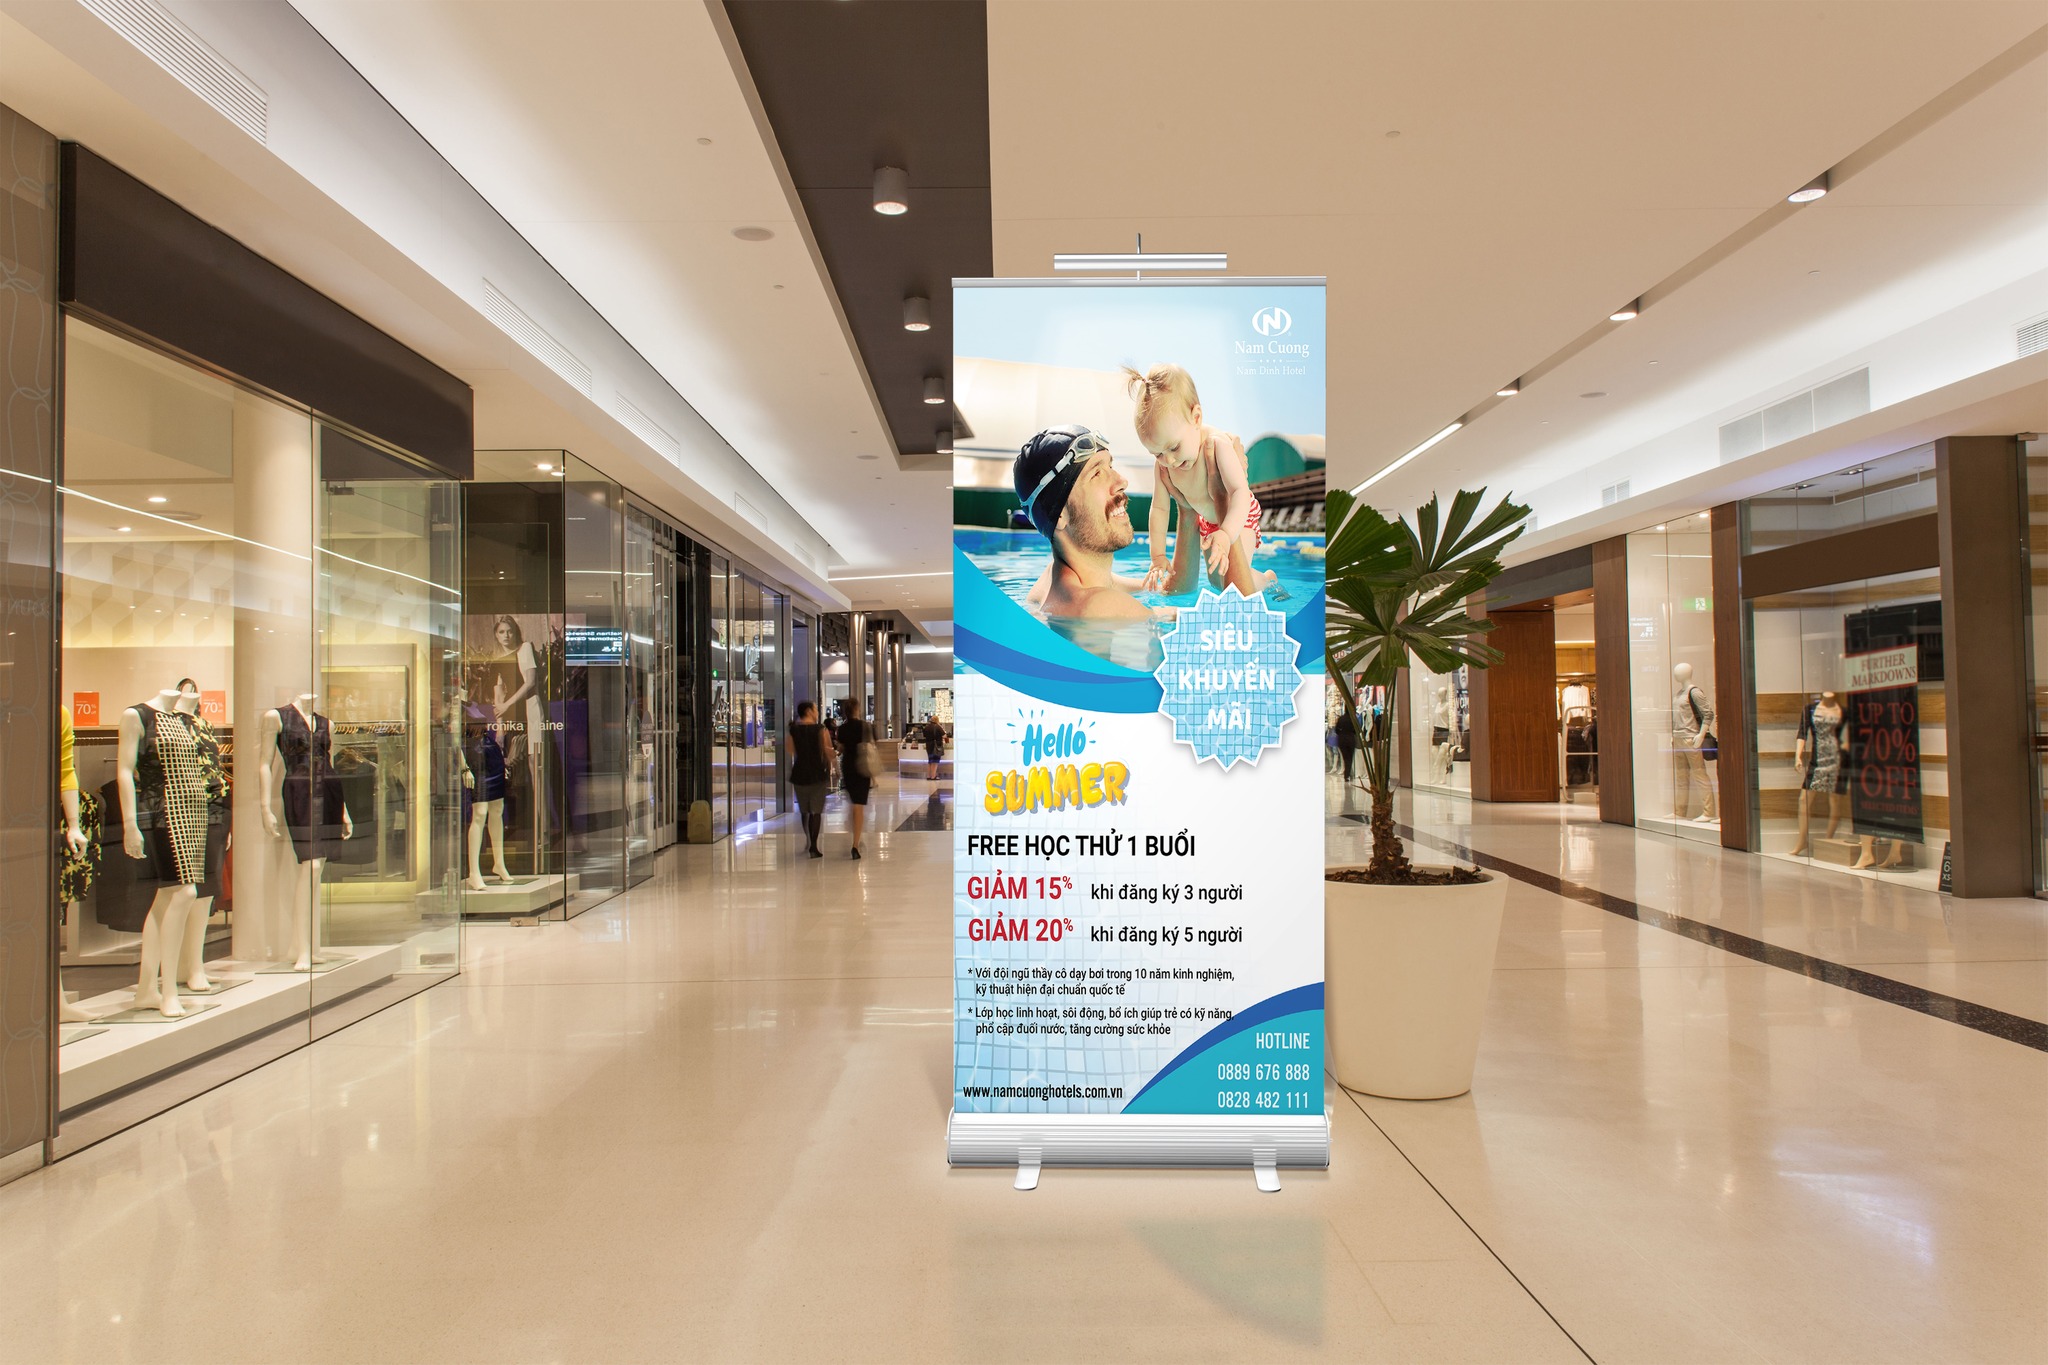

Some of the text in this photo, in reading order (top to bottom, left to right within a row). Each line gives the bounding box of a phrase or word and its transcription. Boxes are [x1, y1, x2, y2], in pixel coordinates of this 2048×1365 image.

[1235, 340, 1310, 358] Nam Cuong
[1236, 365, 1306, 375] Nam Dinh Hotel
[1200, 621, 1253, 651] SIÊU
[1861, 652, 1906, 672] FURTHER
[1178, 656, 1275, 691] KHUYẾN
[1851, 666, 1917, 688] MARKDOWNS
[1207, 701, 1251, 730] MÃI
[1858, 702, 1915, 725] UP TO
[1021, 723, 1086, 767] Hello
[1859, 728, 1916, 763] 70%
[984, 761, 1131, 816] SUMMER
[1860, 764, 1917, 800] OFF
[968, 828, 1195, 861] FREE HỌC THỬ 1 BUỔI
[967, 869, 1243, 904] GIẢM 15% khi đăng ký 3 người
[968, 911, 1243, 946] GIẢM 20% khi đăng ký 5 người
[975, 967, 1235, 981] Với đội ngũ thầy cô dạy bơi trong 10 năm kinh nghiệm,
[975, 983, 987, 997] kỹ
[989, 984, 1014, 996] thuật
[1016, 984, 1037, 996] hiện
[1040, 984, 1055, 996] đại
[1089, 983, 1113, 997] quốc
[1115, 983, 1126, 995] tế
[975, 1007, 993, 1020] Lớp
[996, 1007, 1014, 1019] học
[1016, 1007, 1034, 1018] linh
[1036, 1007, 1060, 1020] hoạt,
[1062, 1007, 1077, 1018] sôi
[1079, 1007, 1106, 1020] động,
[1124, 1007, 1138, 1018] ích
[1141, 1008, 1162, 1021] giúp
[1164, 1007, 1178, 1018] trẻ
[1180, 1008, 1192, 1018] có
[1194, 1008, 1206, 1021] kỹ
[996, 1023, 1014, 1036] cập
[1016, 1022, 1038, 1034] đuối
[1040, 1023, 1067, 1035] nước,
[1069, 1023, 1092, 1036] tăng
[1093, 1023, 1125, 1037] cường
[1127, 1023, 1145, 1035] sức
[1147, 1023, 1171, 1035] khỏe
[1255, 1032, 1310, 1050] HOTLINE
[1217, 1063, 1310, 1081] 0889 676 888
[962, 1083, 1123, 1101] www.namcuonghotels.com.vn
[1217, 1090, 1310, 1109] 0828 482 111
